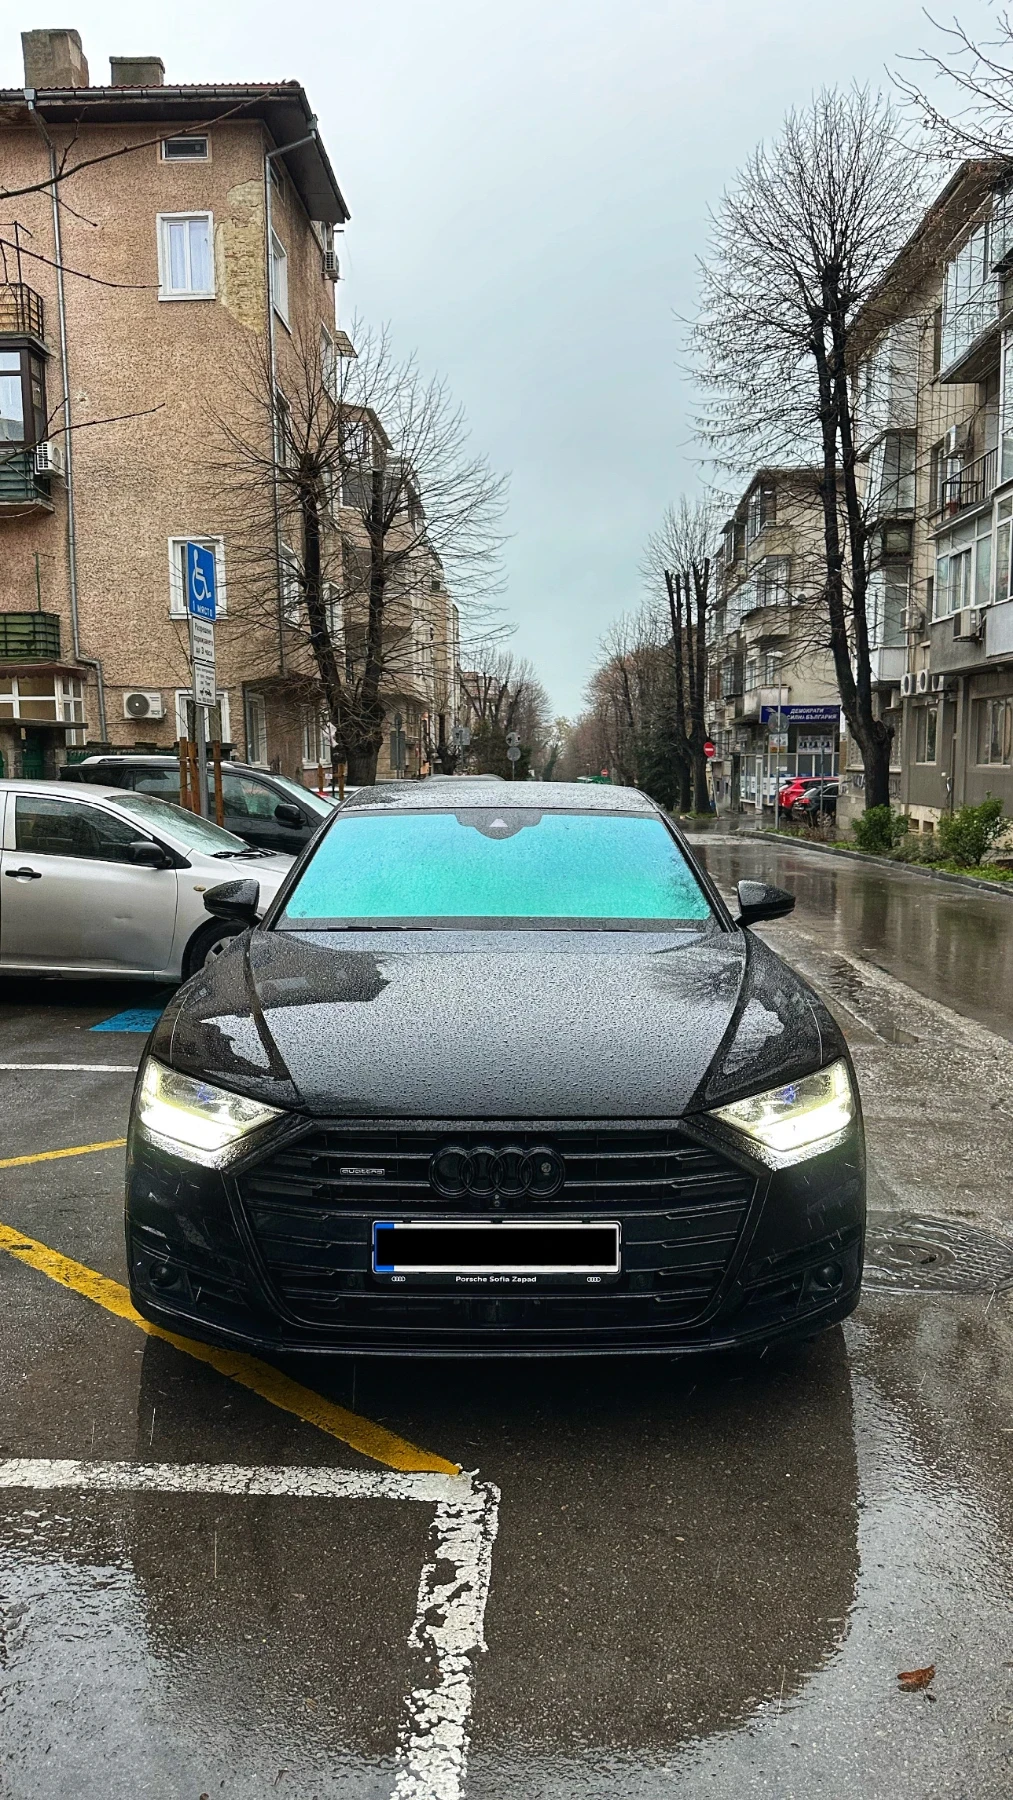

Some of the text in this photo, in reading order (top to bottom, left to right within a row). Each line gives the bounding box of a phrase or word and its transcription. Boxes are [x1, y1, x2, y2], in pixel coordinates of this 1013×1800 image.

[455, 1275, 537, 1284] Porsche Sofia Zapad
